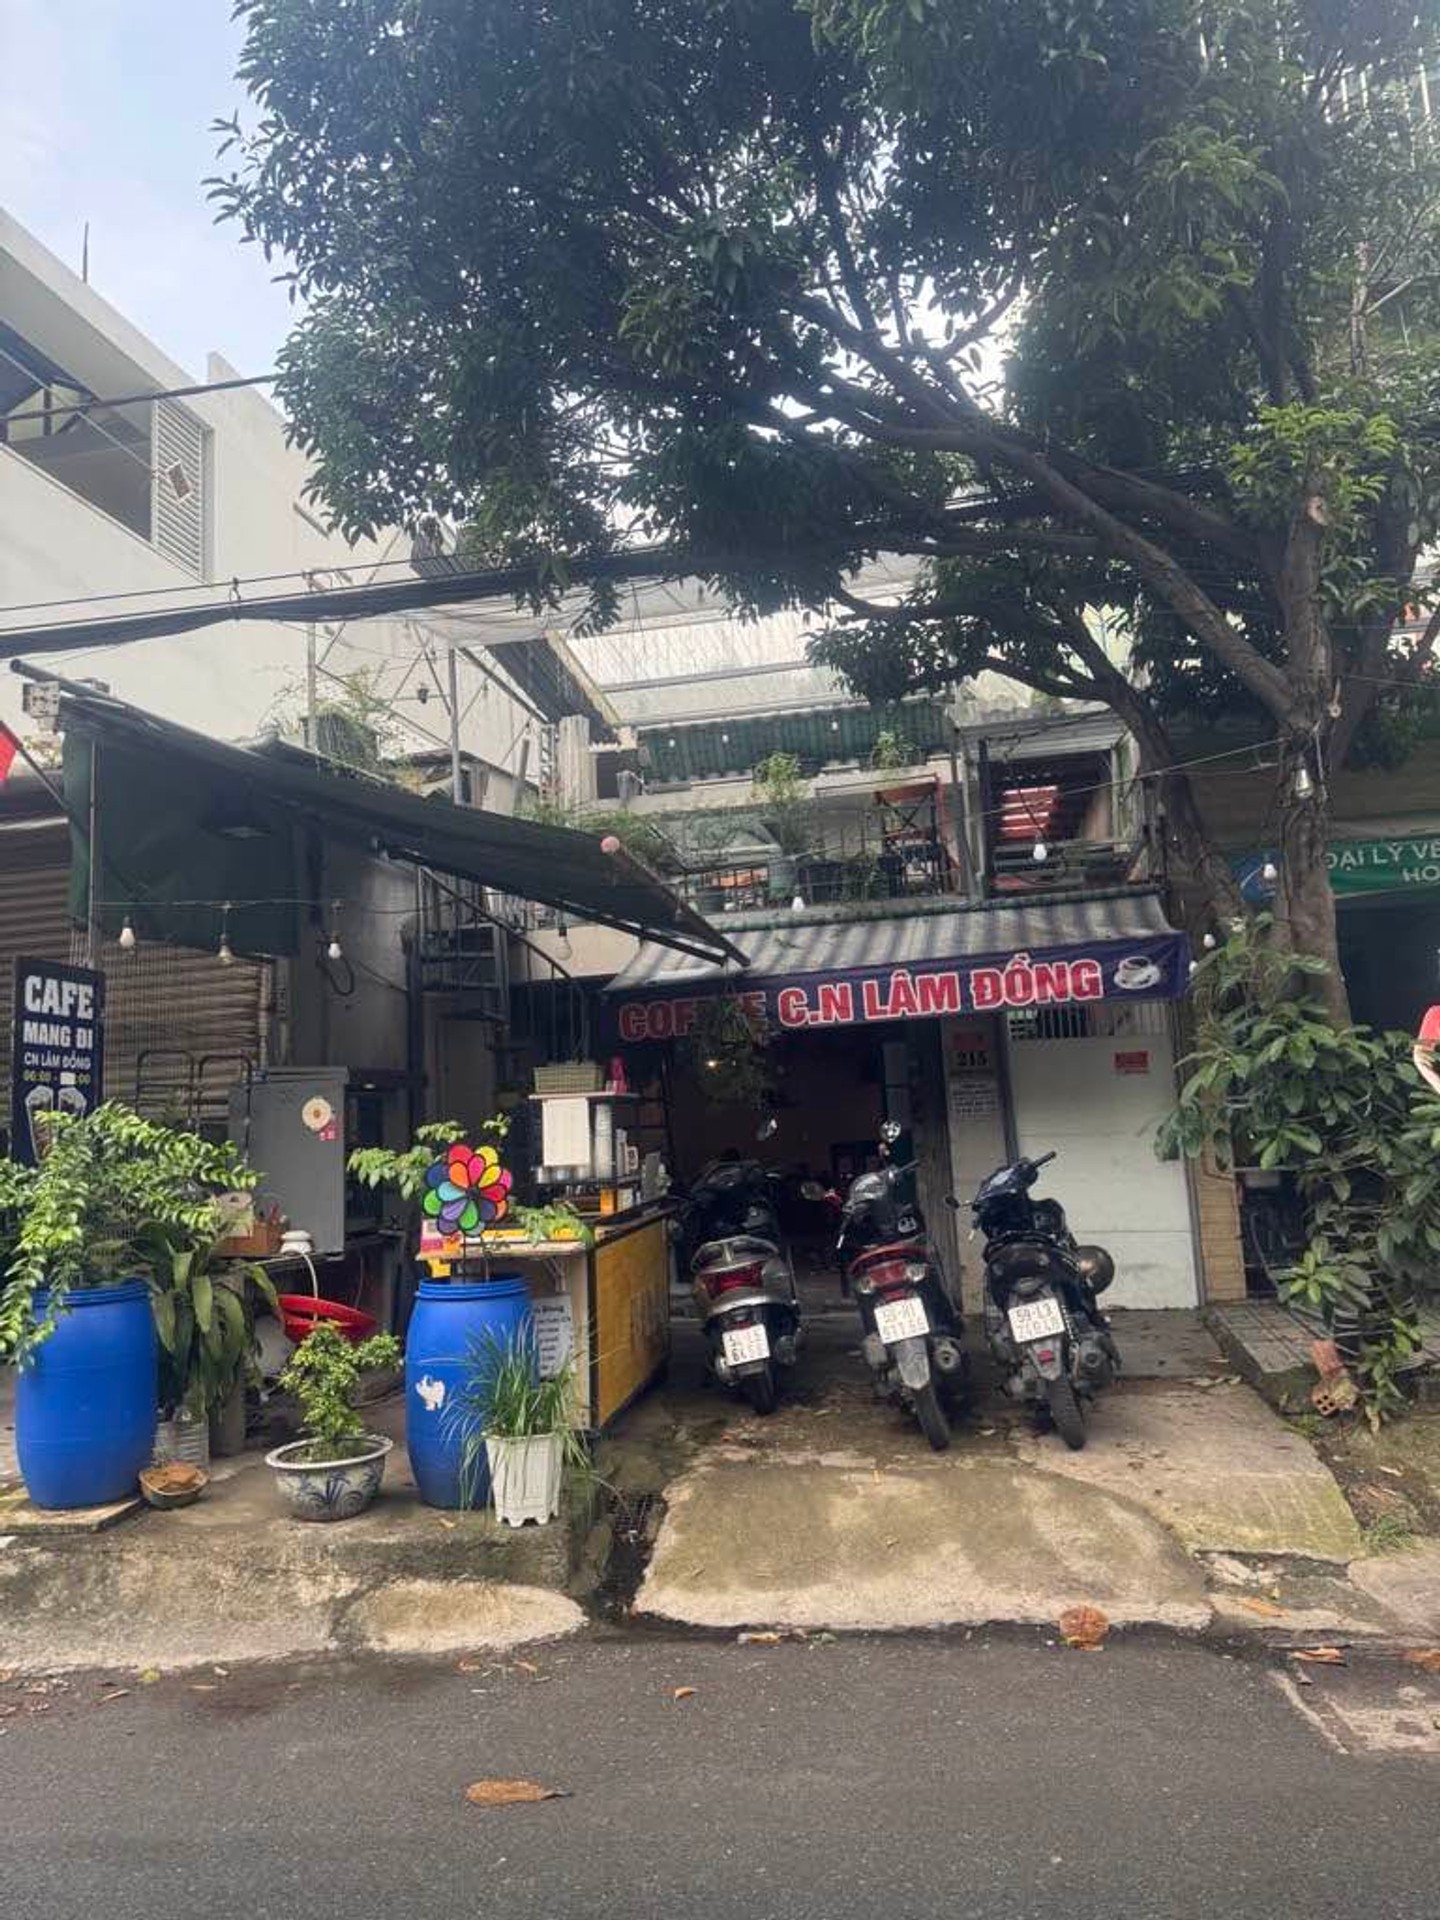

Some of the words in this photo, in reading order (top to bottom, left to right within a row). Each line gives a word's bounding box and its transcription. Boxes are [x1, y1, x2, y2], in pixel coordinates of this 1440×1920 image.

[1373, 842, 1403, 864] LÝ
[24, 974, 94, 1020] CAFE
[778, 986, 855, 1027] C.N
[863, 968, 962, 1020] LÂM
[970, 952, 1105, 1010] ĐỒNG
[24, 1021, 71, 1047] MANG
[25, 1052, 39, 1065] CN
[42, 1050, 61, 1067] LÂM
